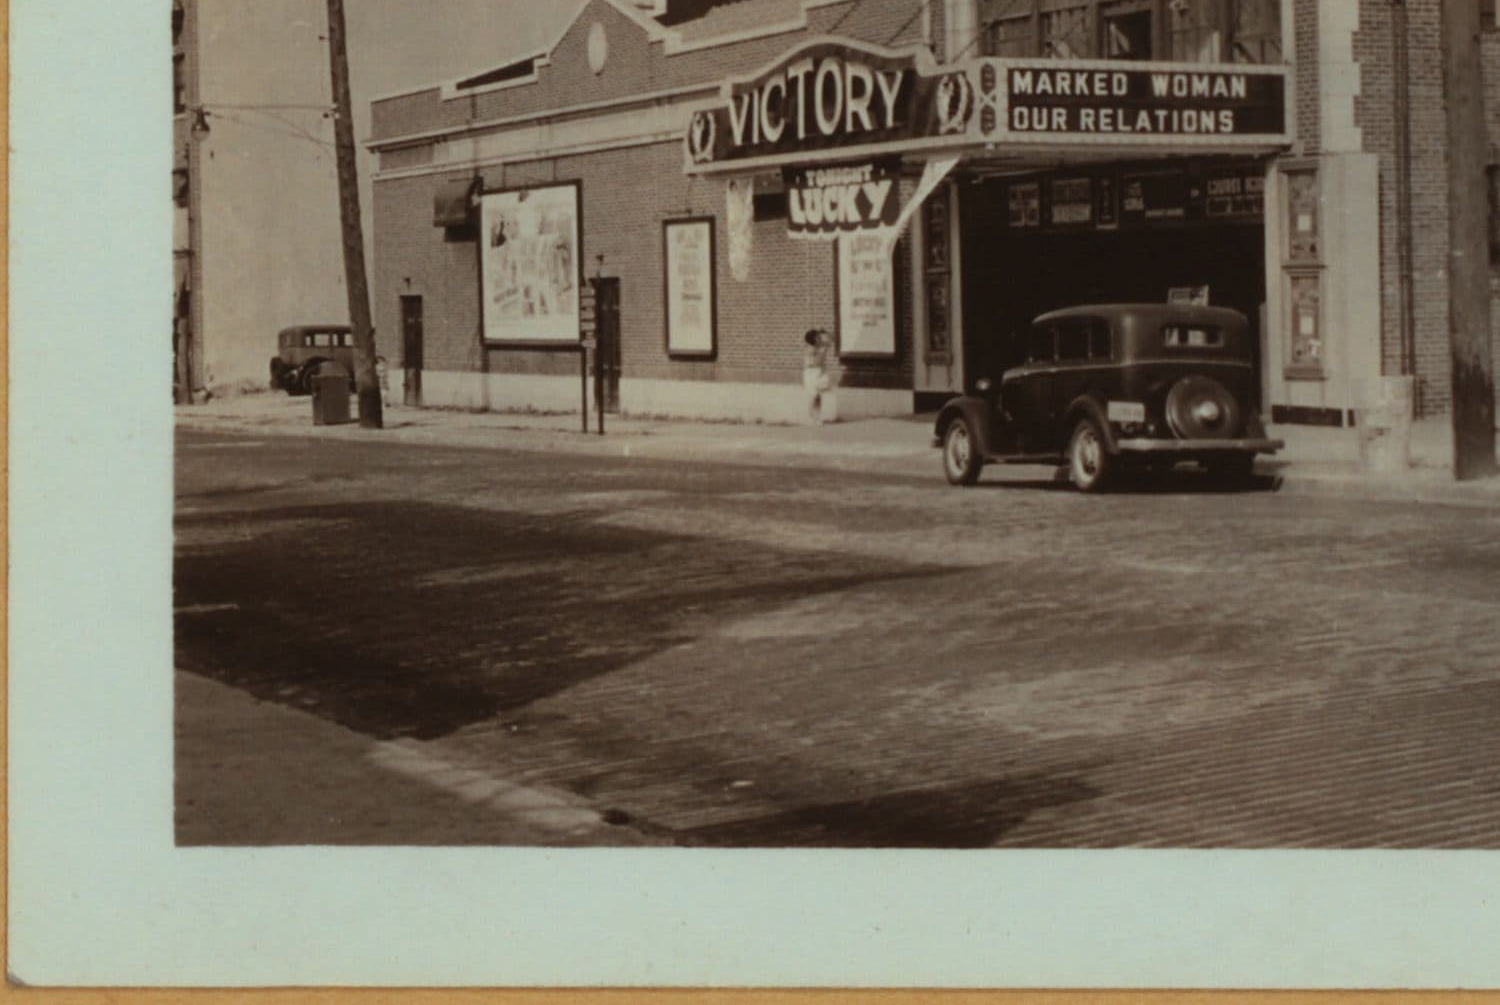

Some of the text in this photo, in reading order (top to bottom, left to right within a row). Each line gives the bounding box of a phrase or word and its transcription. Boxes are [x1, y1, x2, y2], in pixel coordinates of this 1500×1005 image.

[728, 57, 903, 146] VICTORY
[1013, 71, 1247, 97] MARKED WOMAN
[1013, 106, 1235, 132] OUR RELATIONS
[789, 180, 893, 225] LUCKY
